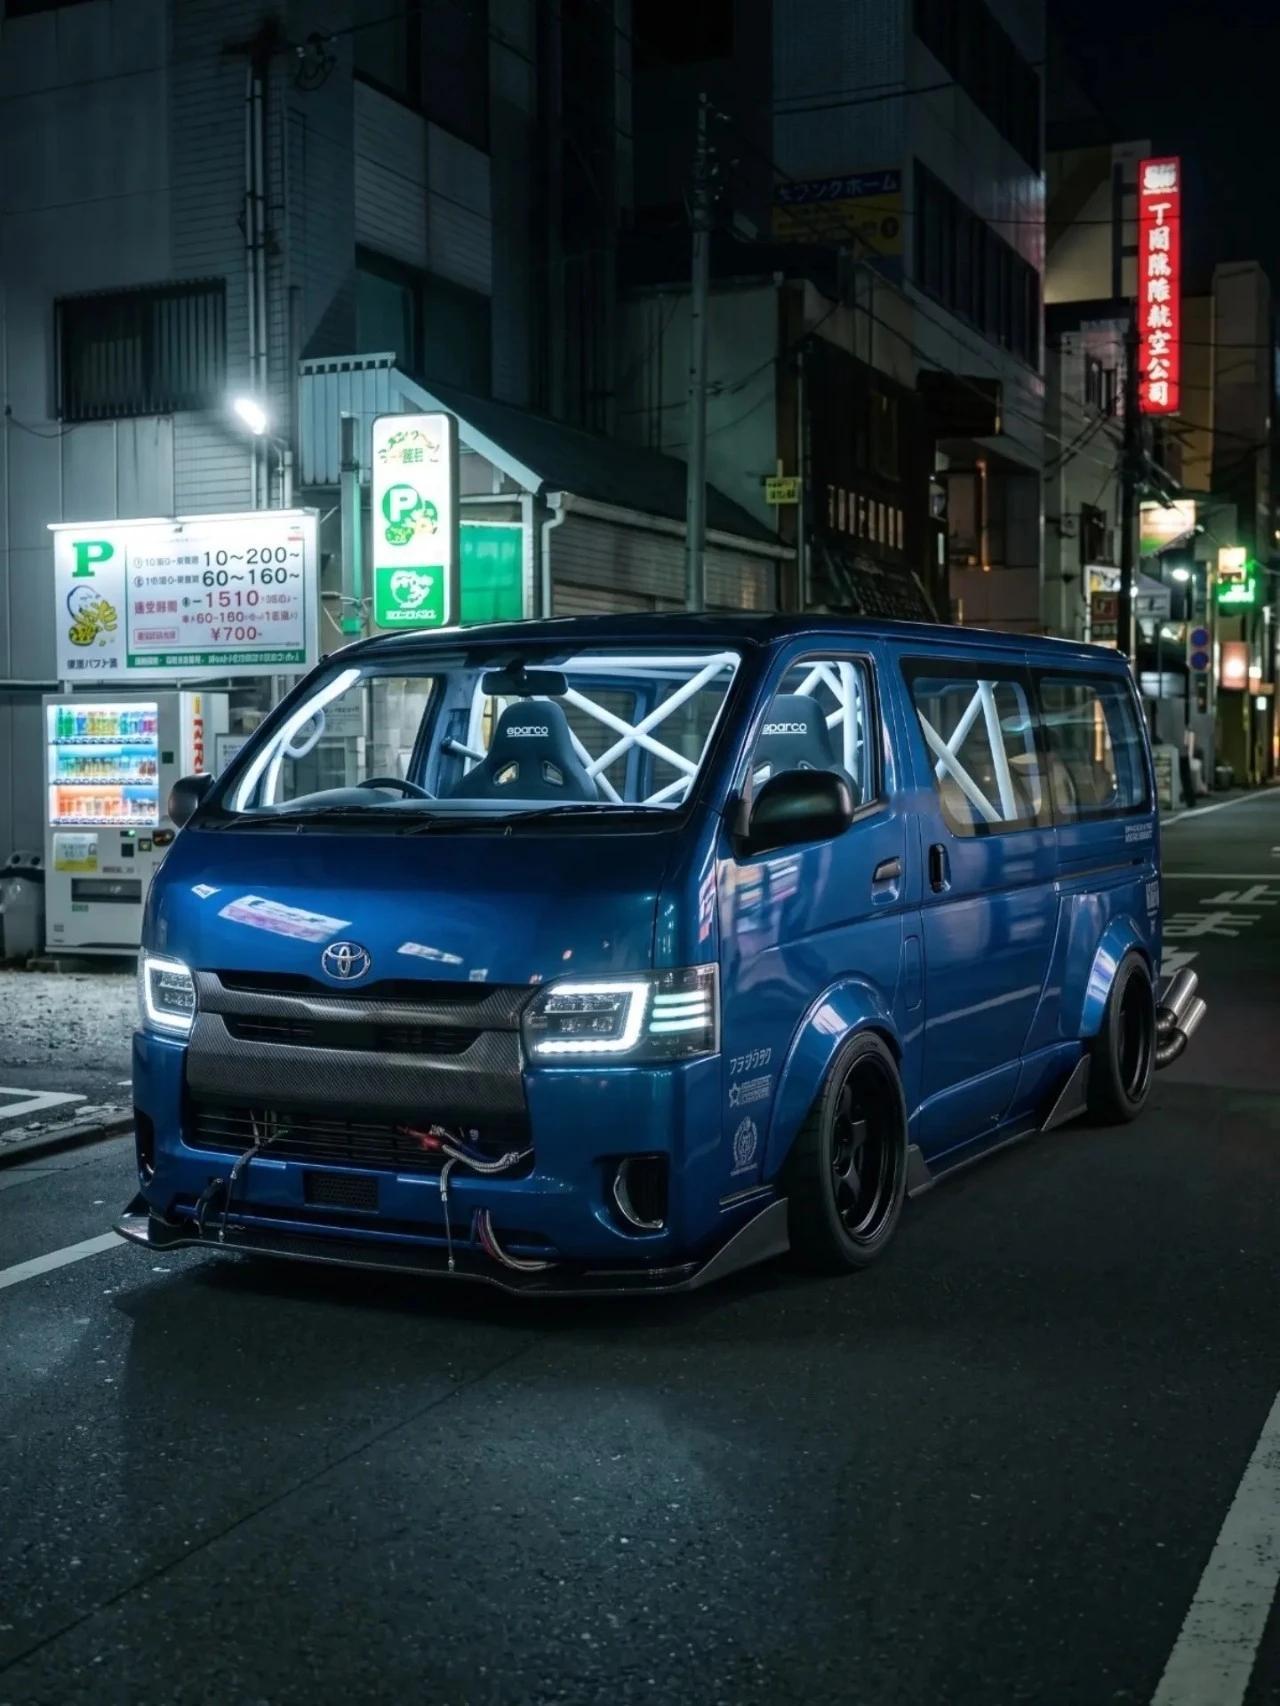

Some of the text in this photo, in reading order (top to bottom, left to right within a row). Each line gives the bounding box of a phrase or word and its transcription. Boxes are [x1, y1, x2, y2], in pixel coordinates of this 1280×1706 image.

[390, 488, 418, 522] P
[72, 540, 115, 578] P
[506, 726, 549, 736] sparco
[761, 721, 808, 733] sparco
